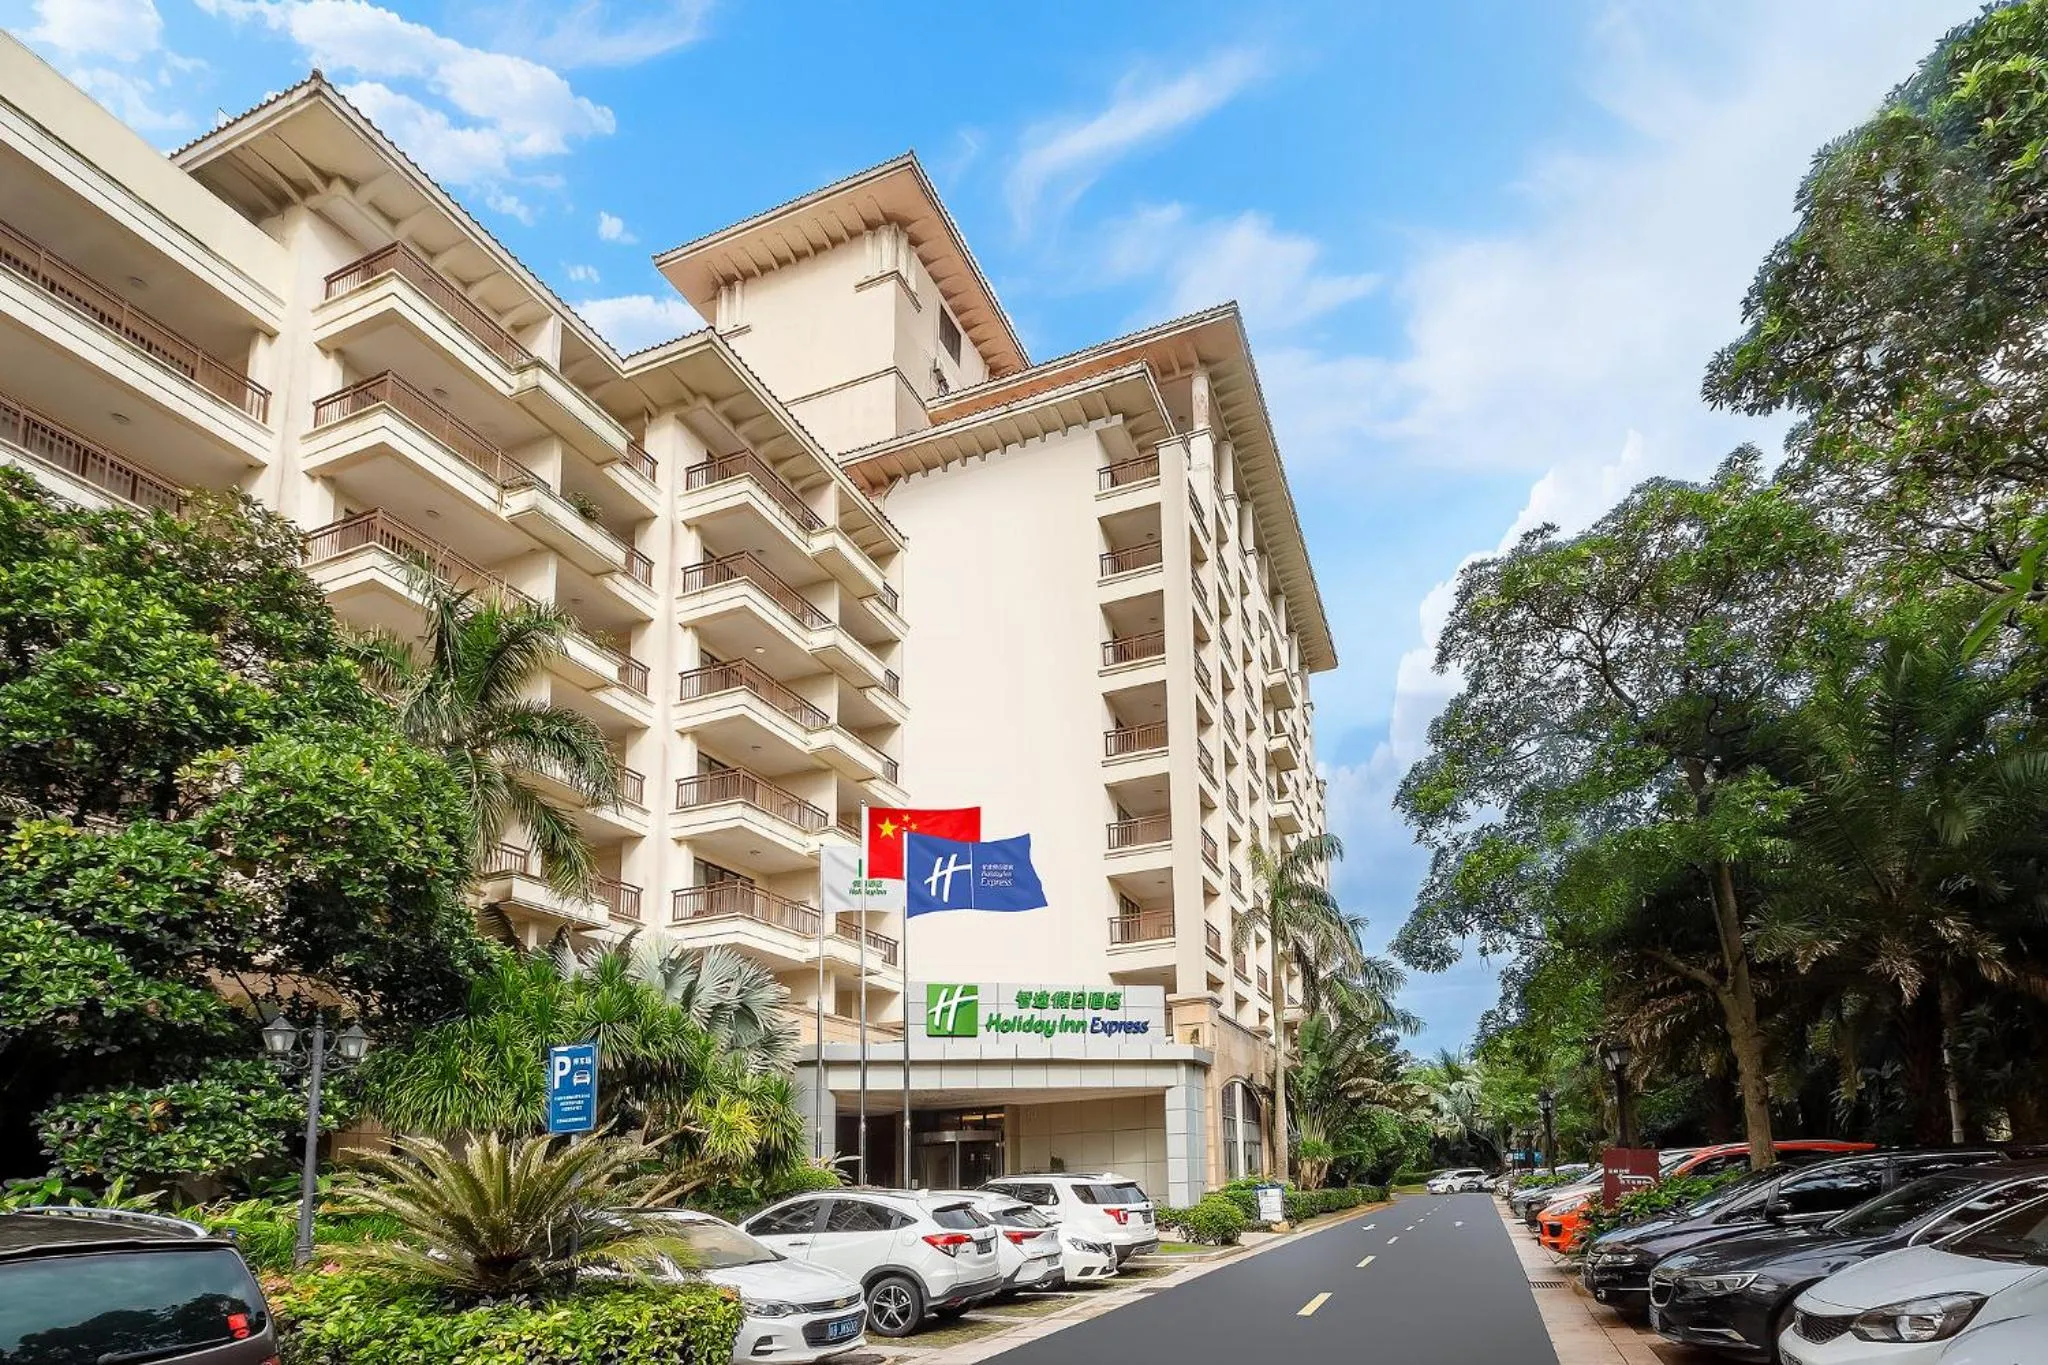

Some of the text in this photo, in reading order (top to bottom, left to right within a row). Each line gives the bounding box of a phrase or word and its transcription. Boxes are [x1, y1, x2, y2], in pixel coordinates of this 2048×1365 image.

[985, 1012, 1151, 1038] Holiday Inn Express
[554, 1056, 572, 1090] P
